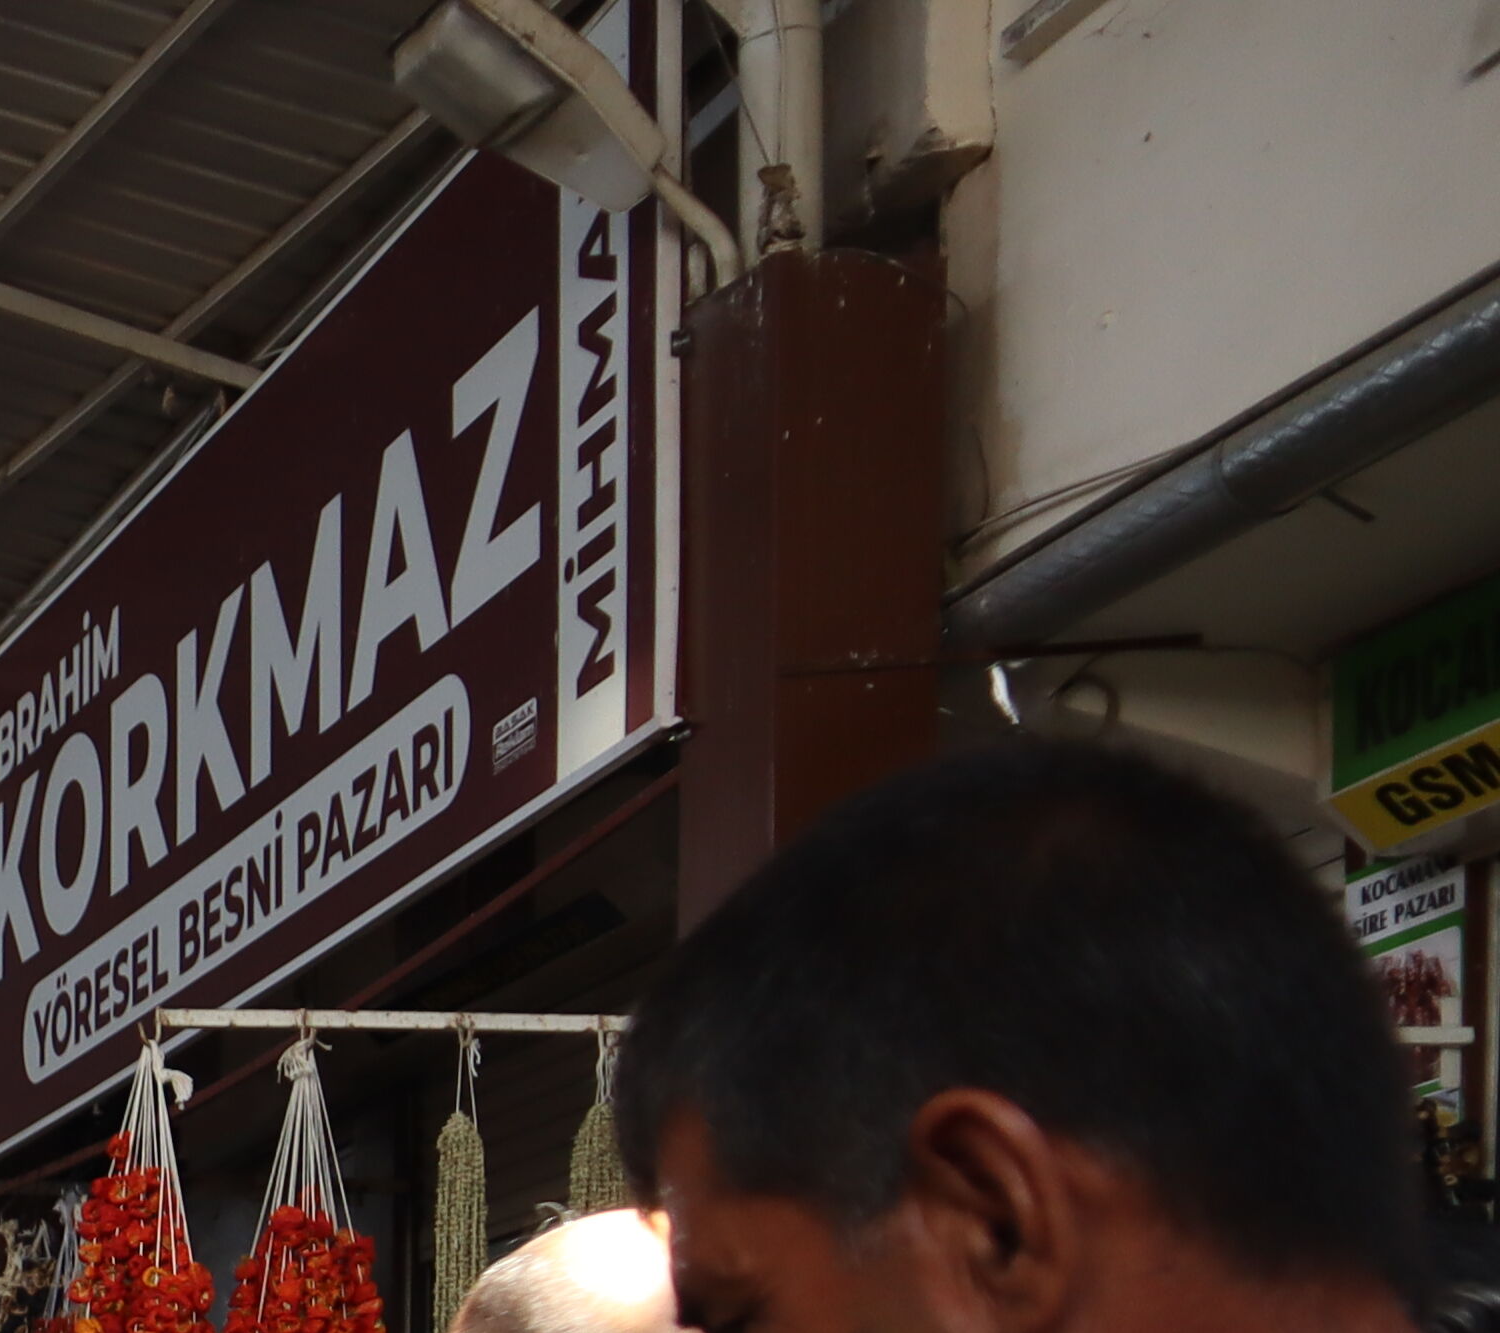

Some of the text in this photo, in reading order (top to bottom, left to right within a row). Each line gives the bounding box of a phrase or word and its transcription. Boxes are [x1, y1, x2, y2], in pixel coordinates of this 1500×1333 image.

[565, 195, 618, 700] MİHMA
[33, 926, 168, 1067] YÖRESEL
[179, 810, 283, 976] BESNİ
[297, 706, 454, 893] PAZARI
[1375, 741, 1500, 825] GSM
[1393, 882, 1455, 924] PAZARI
